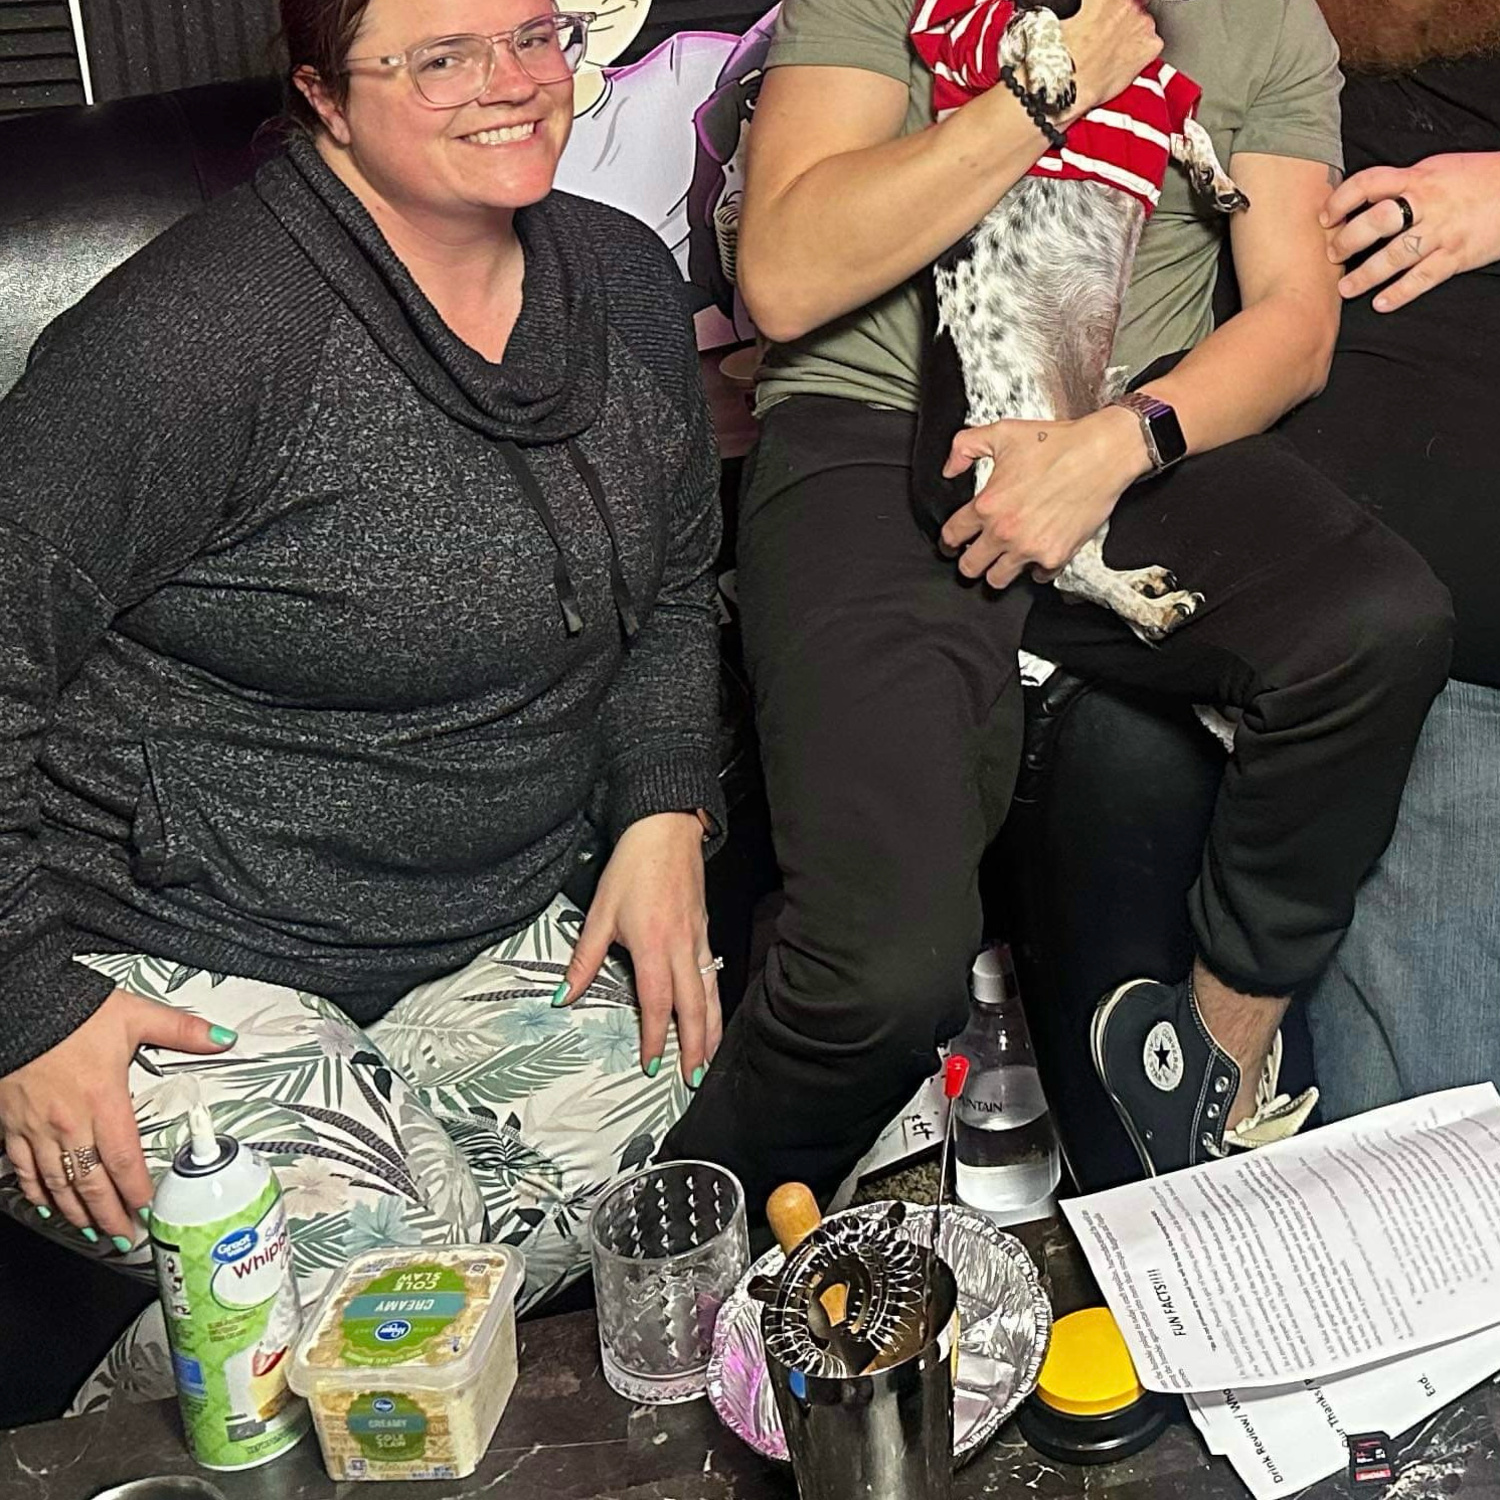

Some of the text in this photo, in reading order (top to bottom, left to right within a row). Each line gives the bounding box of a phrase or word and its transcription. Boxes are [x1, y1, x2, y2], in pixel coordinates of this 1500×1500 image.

[217, 1233, 252, 1254] Great
[393, 1279, 438, 1291] COLE
[398, 1271, 443, 1282] SLAW
[375, 1299, 436, 1313] CREAMY
[1168, 1316, 1187, 1336] FUN
[1418, 1372, 1436, 1397] End.
[1263, 1455, 1283, 1484] Drink
